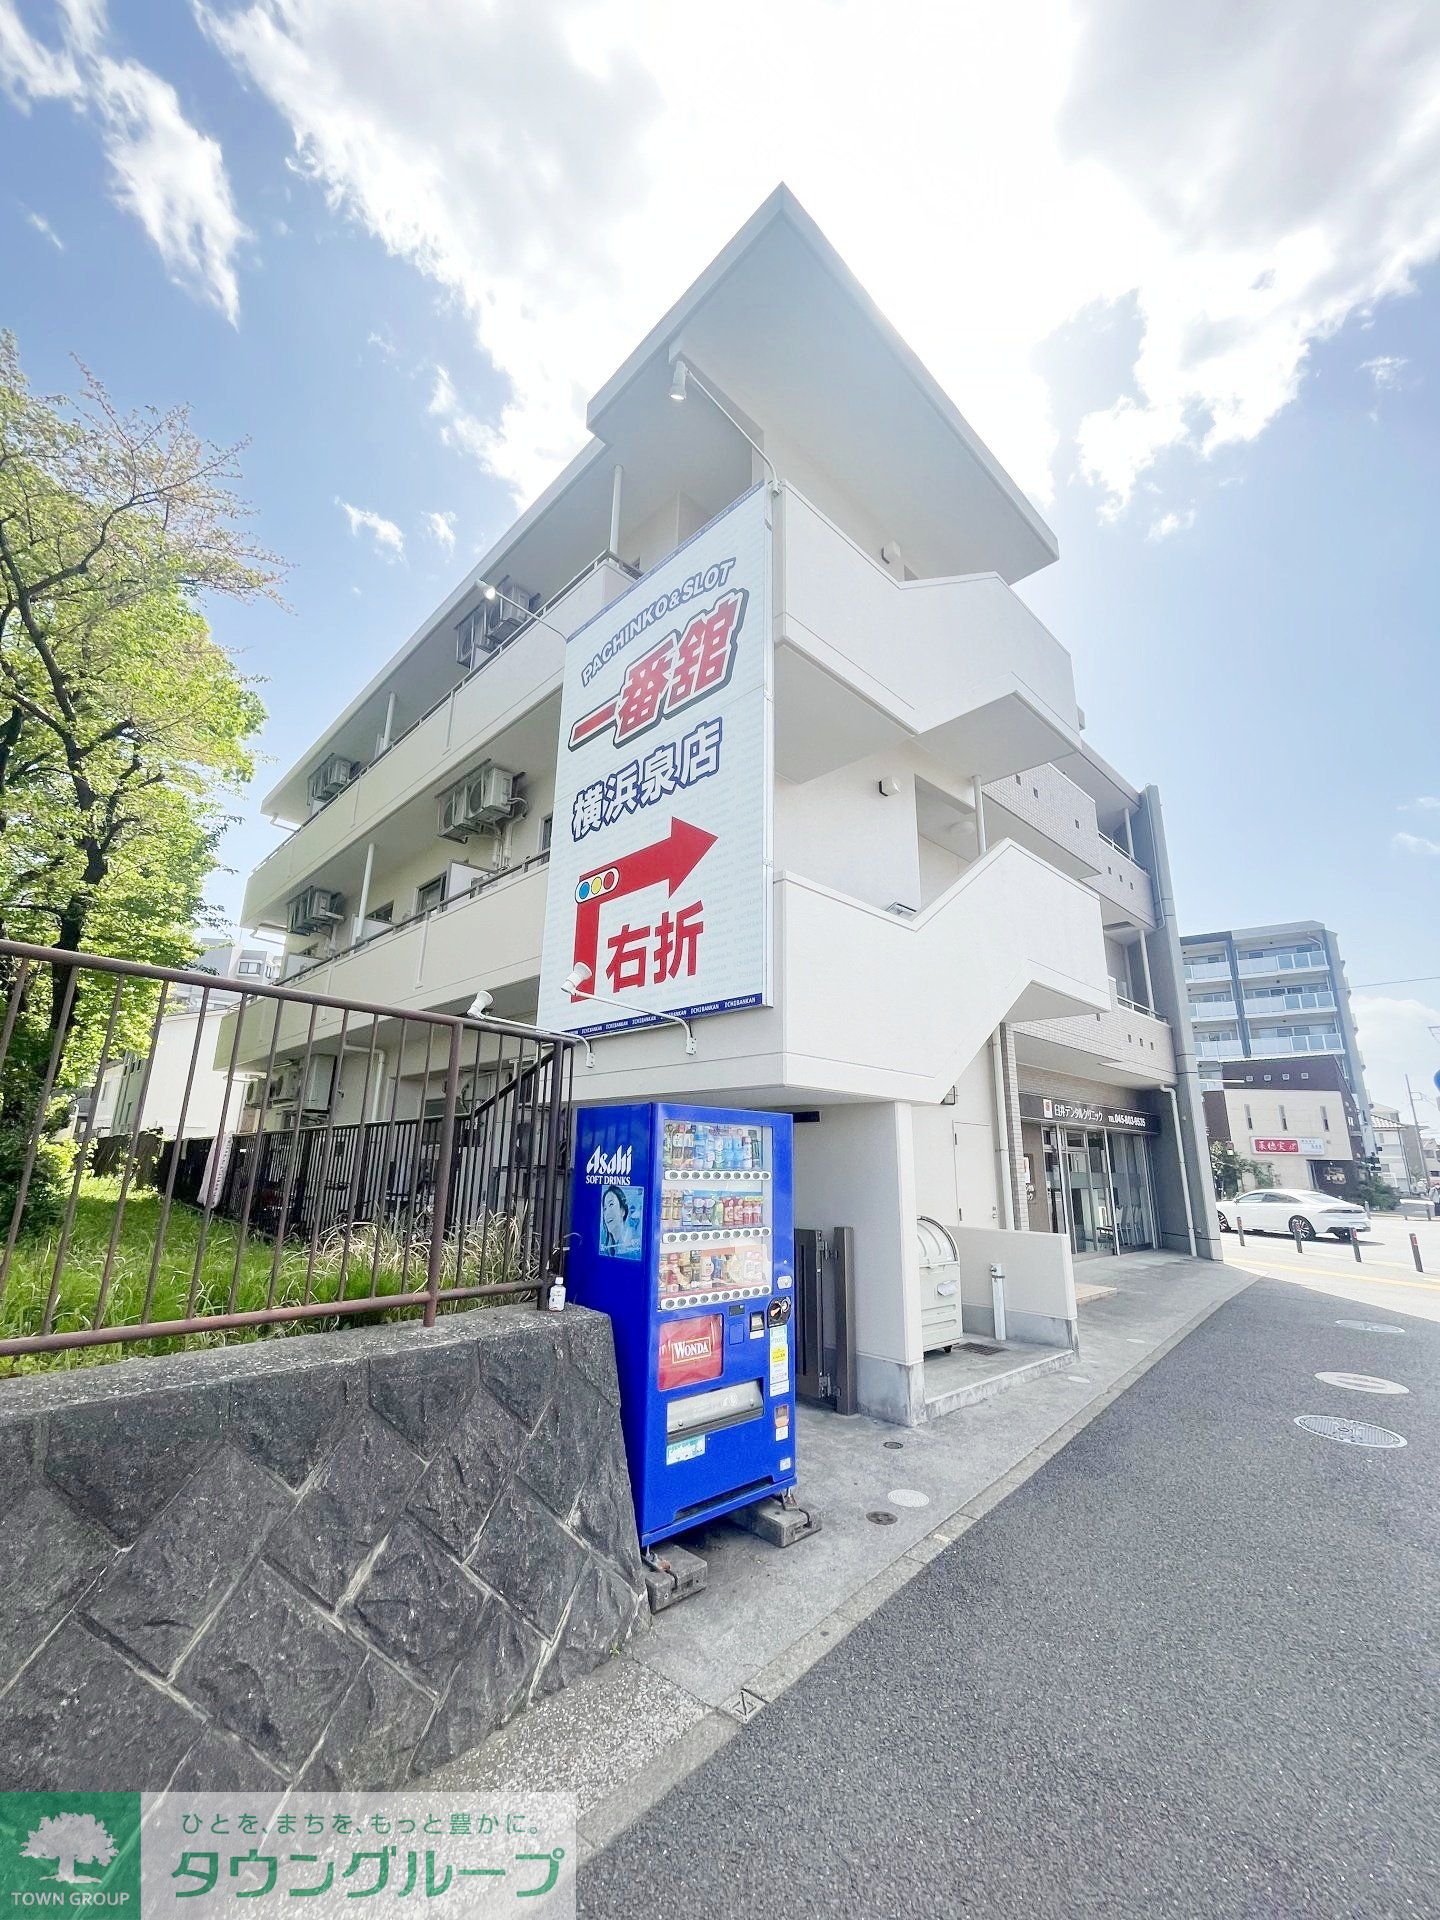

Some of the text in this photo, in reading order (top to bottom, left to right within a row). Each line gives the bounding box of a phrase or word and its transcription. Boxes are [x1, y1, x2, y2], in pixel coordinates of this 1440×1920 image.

[581, 557, 736, 687] PACHINKO&SLOT
[572, 717, 722, 841] 横浜泉店
[606, 901, 703, 993] 右折
[724, 997, 756, 1008] ICHIBANKAN
[585, 1175, 631, 1186] SOFT DRINKS
[586, 1145, 632, 1175] Asahi
